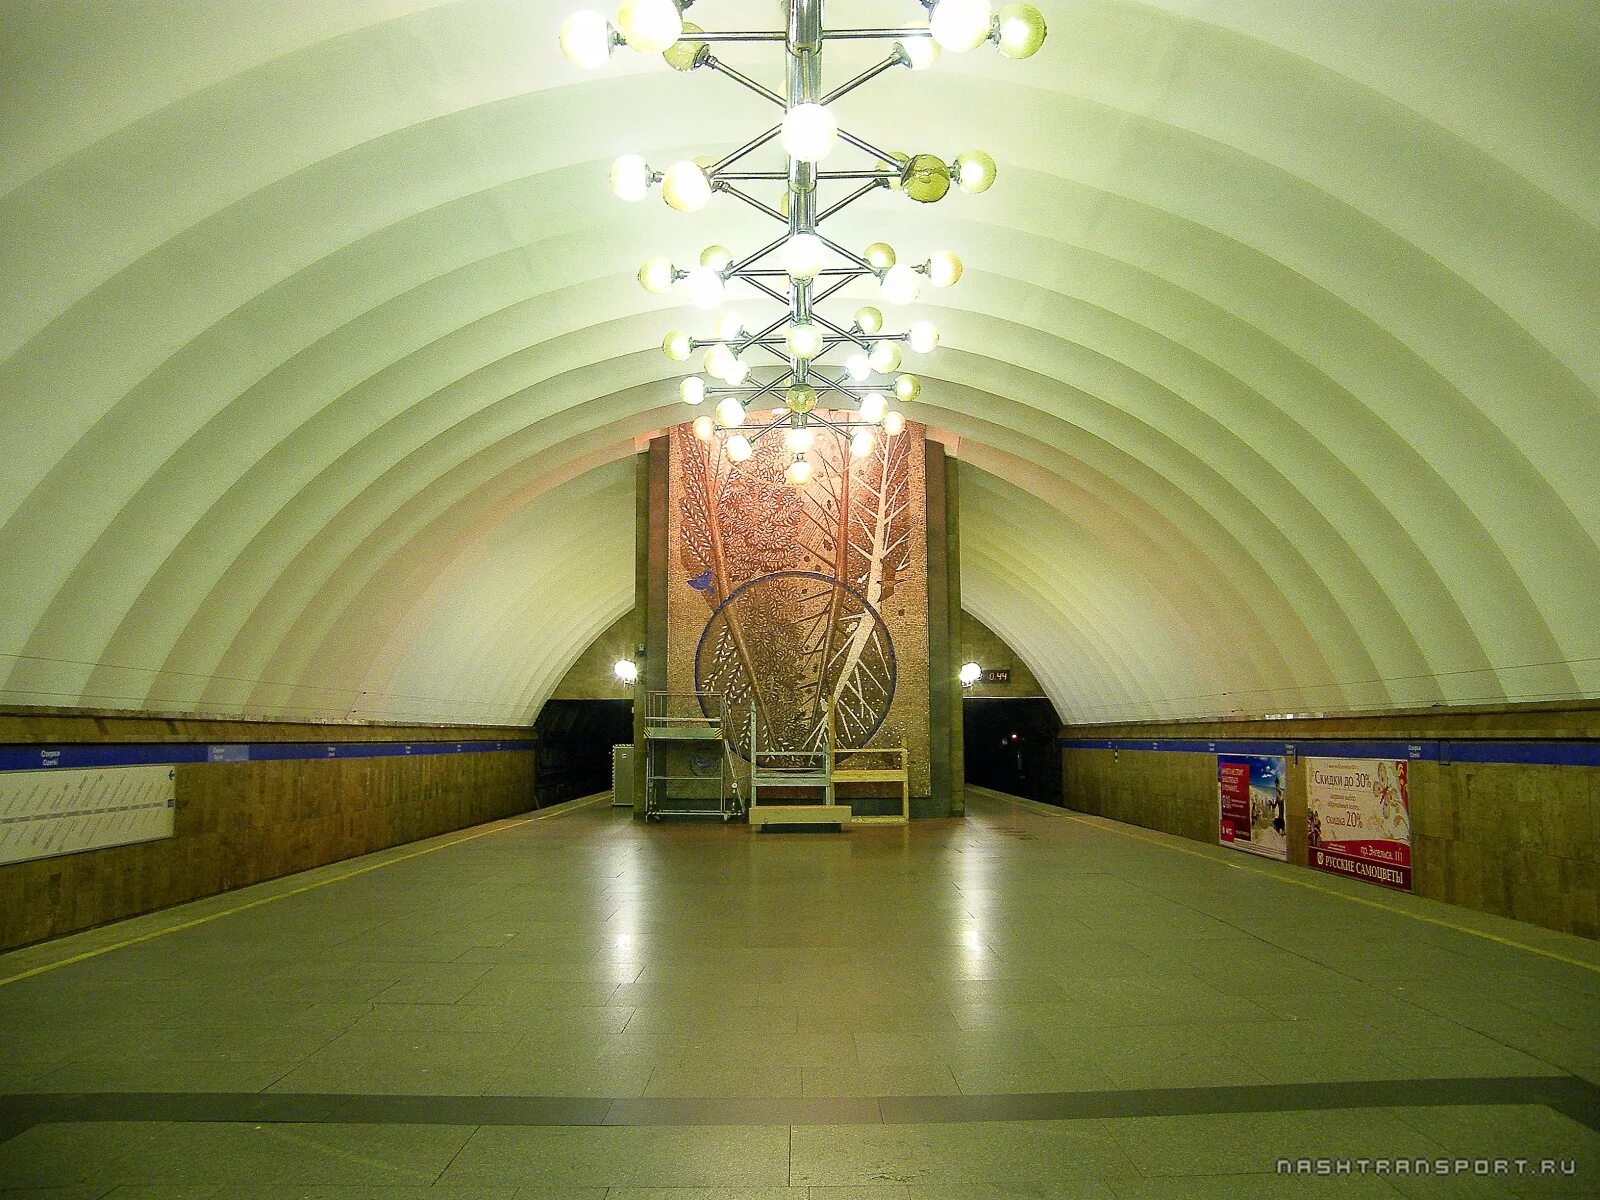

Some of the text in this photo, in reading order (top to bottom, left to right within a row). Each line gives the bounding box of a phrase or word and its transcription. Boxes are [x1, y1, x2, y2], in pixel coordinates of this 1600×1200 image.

[1314, 770, 1372, 789] Скидки до 30%
[1346, 811, 1363, 829] 20%
[1325, 855, 1403, 884] РУССКИЕ САМОЦВЕТЫ
